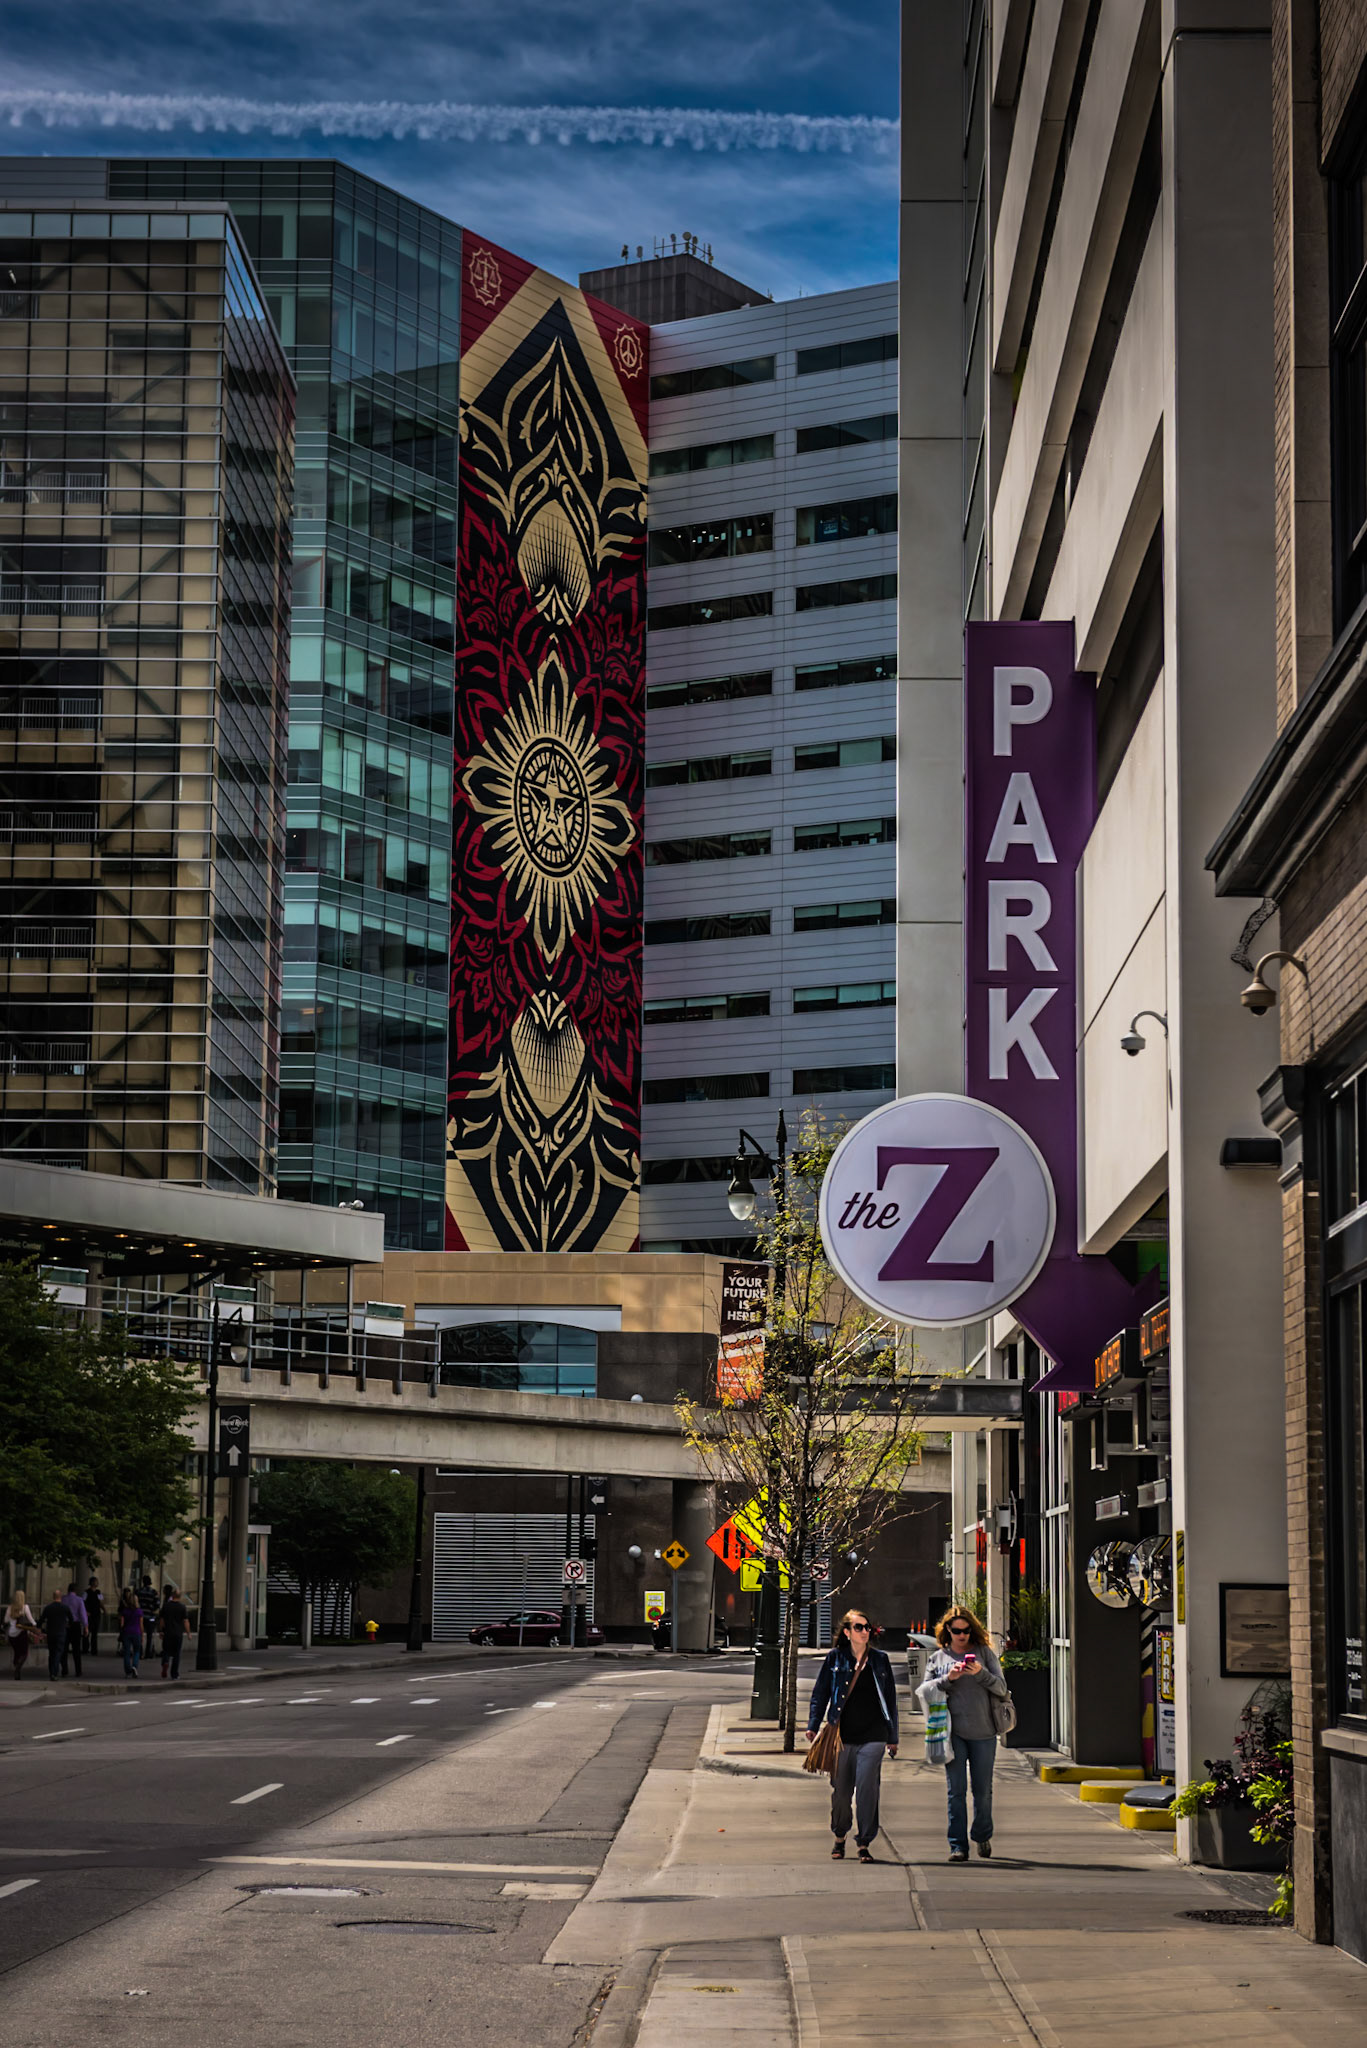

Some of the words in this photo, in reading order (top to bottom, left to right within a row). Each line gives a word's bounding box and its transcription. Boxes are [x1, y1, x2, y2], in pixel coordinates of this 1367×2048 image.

[985, 666, 1060, 1080] PARK
[838, 1192, 901, 1230] the
[876, 1145, 1000, 1283] Z
[728, 1276, 762, 1287] YOUR
[723, 1287, 766, 1299] FUTURE
[738, 1299, 751, 1310] IS
